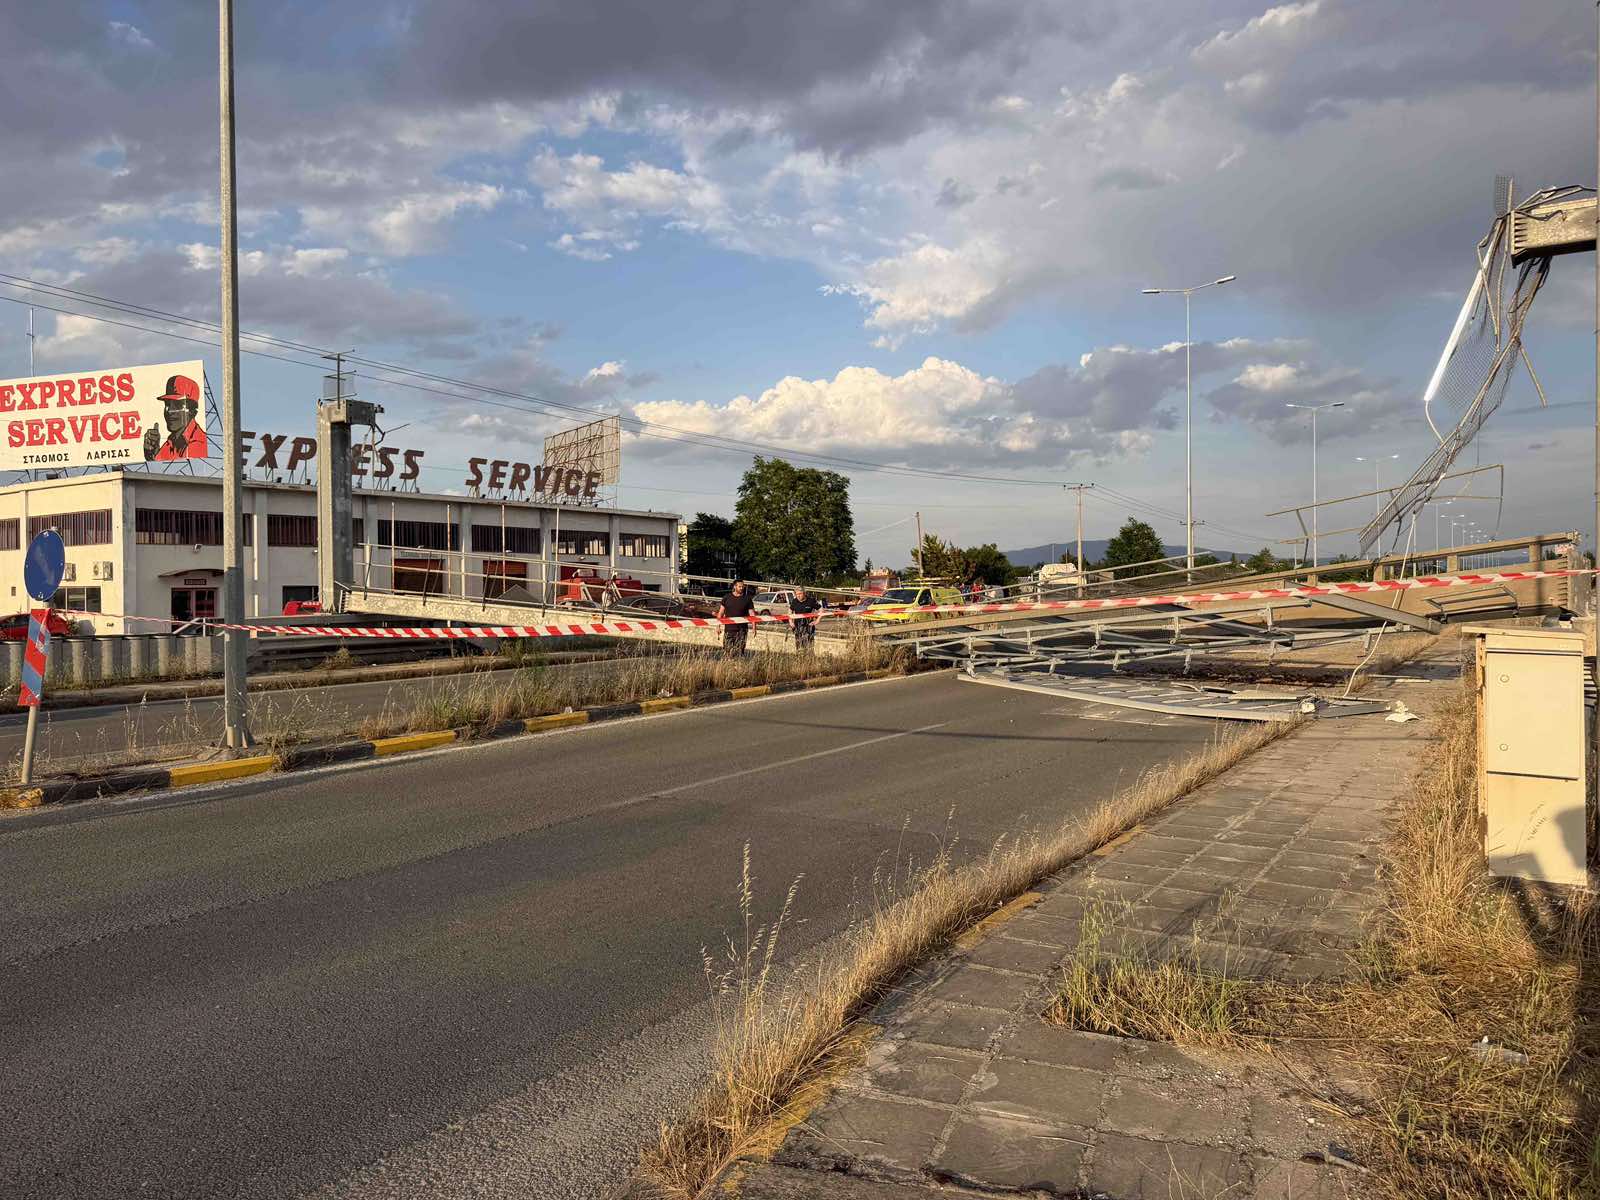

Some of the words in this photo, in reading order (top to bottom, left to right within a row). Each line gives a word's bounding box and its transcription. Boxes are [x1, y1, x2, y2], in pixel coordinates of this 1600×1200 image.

[0, 373, 135, 412] EXPRESS
[8, 411, 142, 447] SERVICE
[23, 453, 70, 463] ΣΤΑΘΜΟΣ
[87, 449, 131, 460] ΛΑΡΙΣΑΣ
[241, 431, 424, 478] EXPESS
[465, 457, 602, 497] SERVICE
